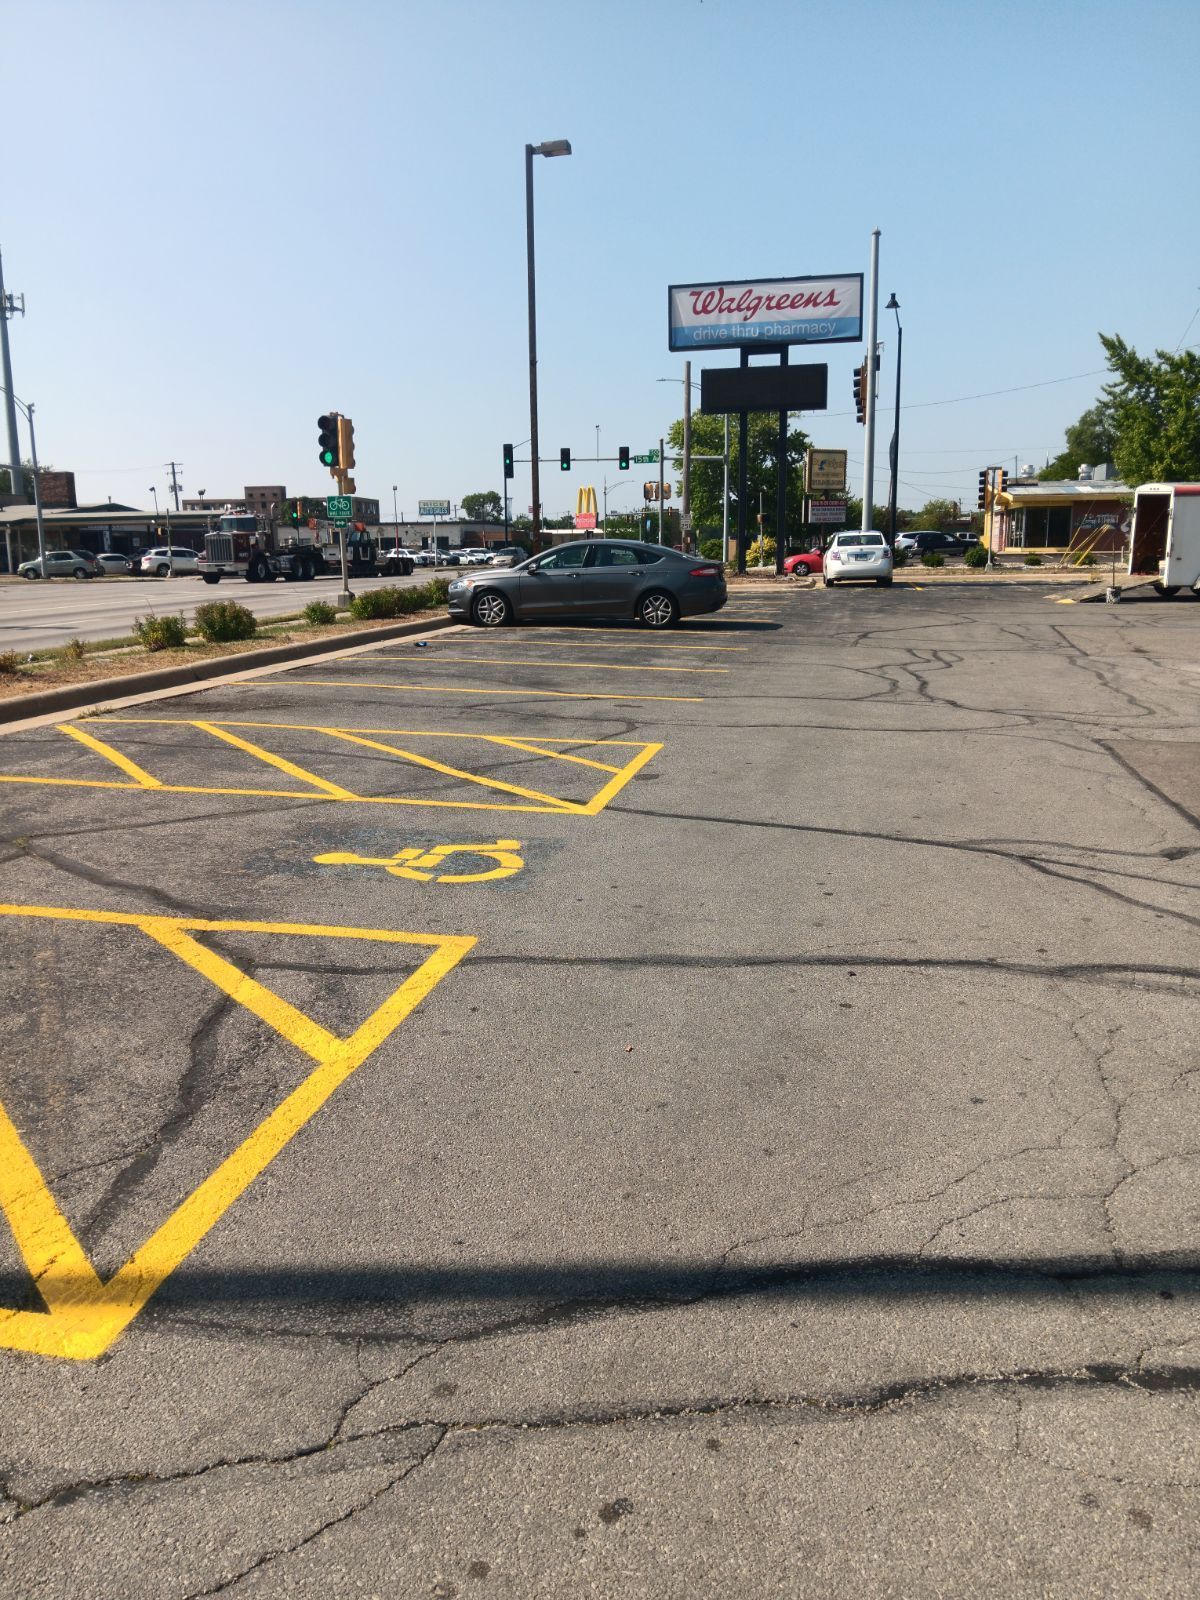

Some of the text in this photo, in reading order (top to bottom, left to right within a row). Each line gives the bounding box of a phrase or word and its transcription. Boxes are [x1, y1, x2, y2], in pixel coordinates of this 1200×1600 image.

[689, 287, 841, 321] Walgreens
[693, 321, 836, 341] drive thru pharmacy
